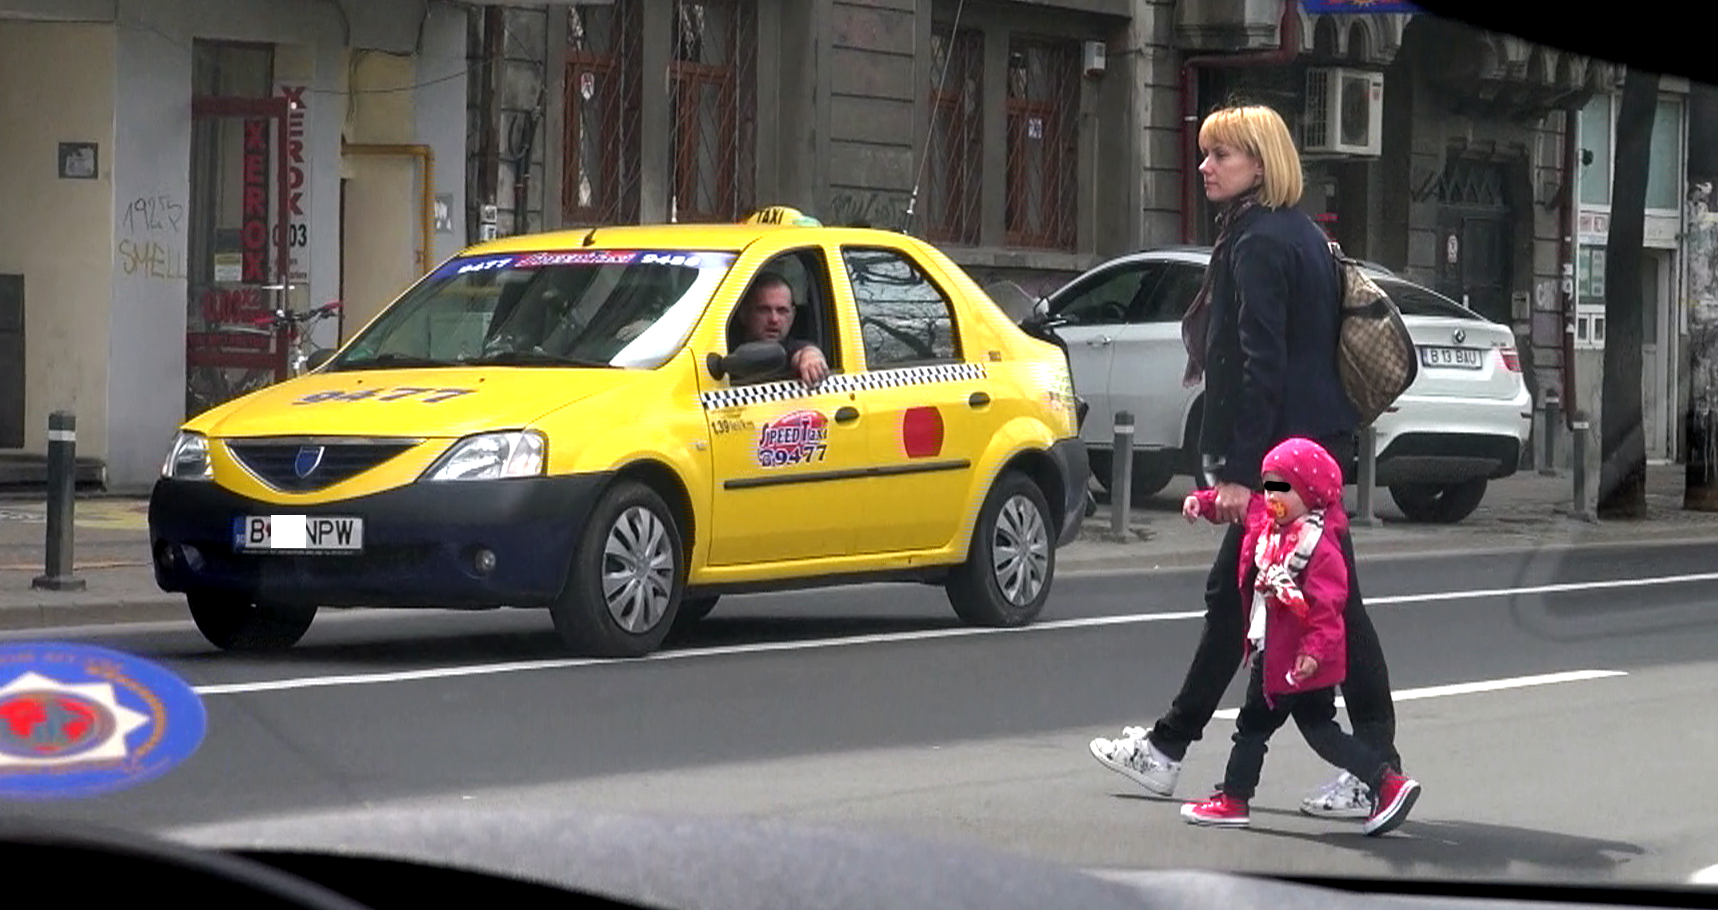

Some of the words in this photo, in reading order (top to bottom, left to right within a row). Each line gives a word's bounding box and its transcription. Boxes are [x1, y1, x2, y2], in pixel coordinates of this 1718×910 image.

[243, 119, 270, 282] XEROX
[756, 207, 784, 225] TAXI
[119, 239, 187, 279] SMELL
[1431, 350, 1439, 363] B
[1442, 350, 1451, 363] 13
[1456, 350, 1476, 364] BAU
[775, 444, 828, 465] 9477
[250, 518, 264, 543] B
